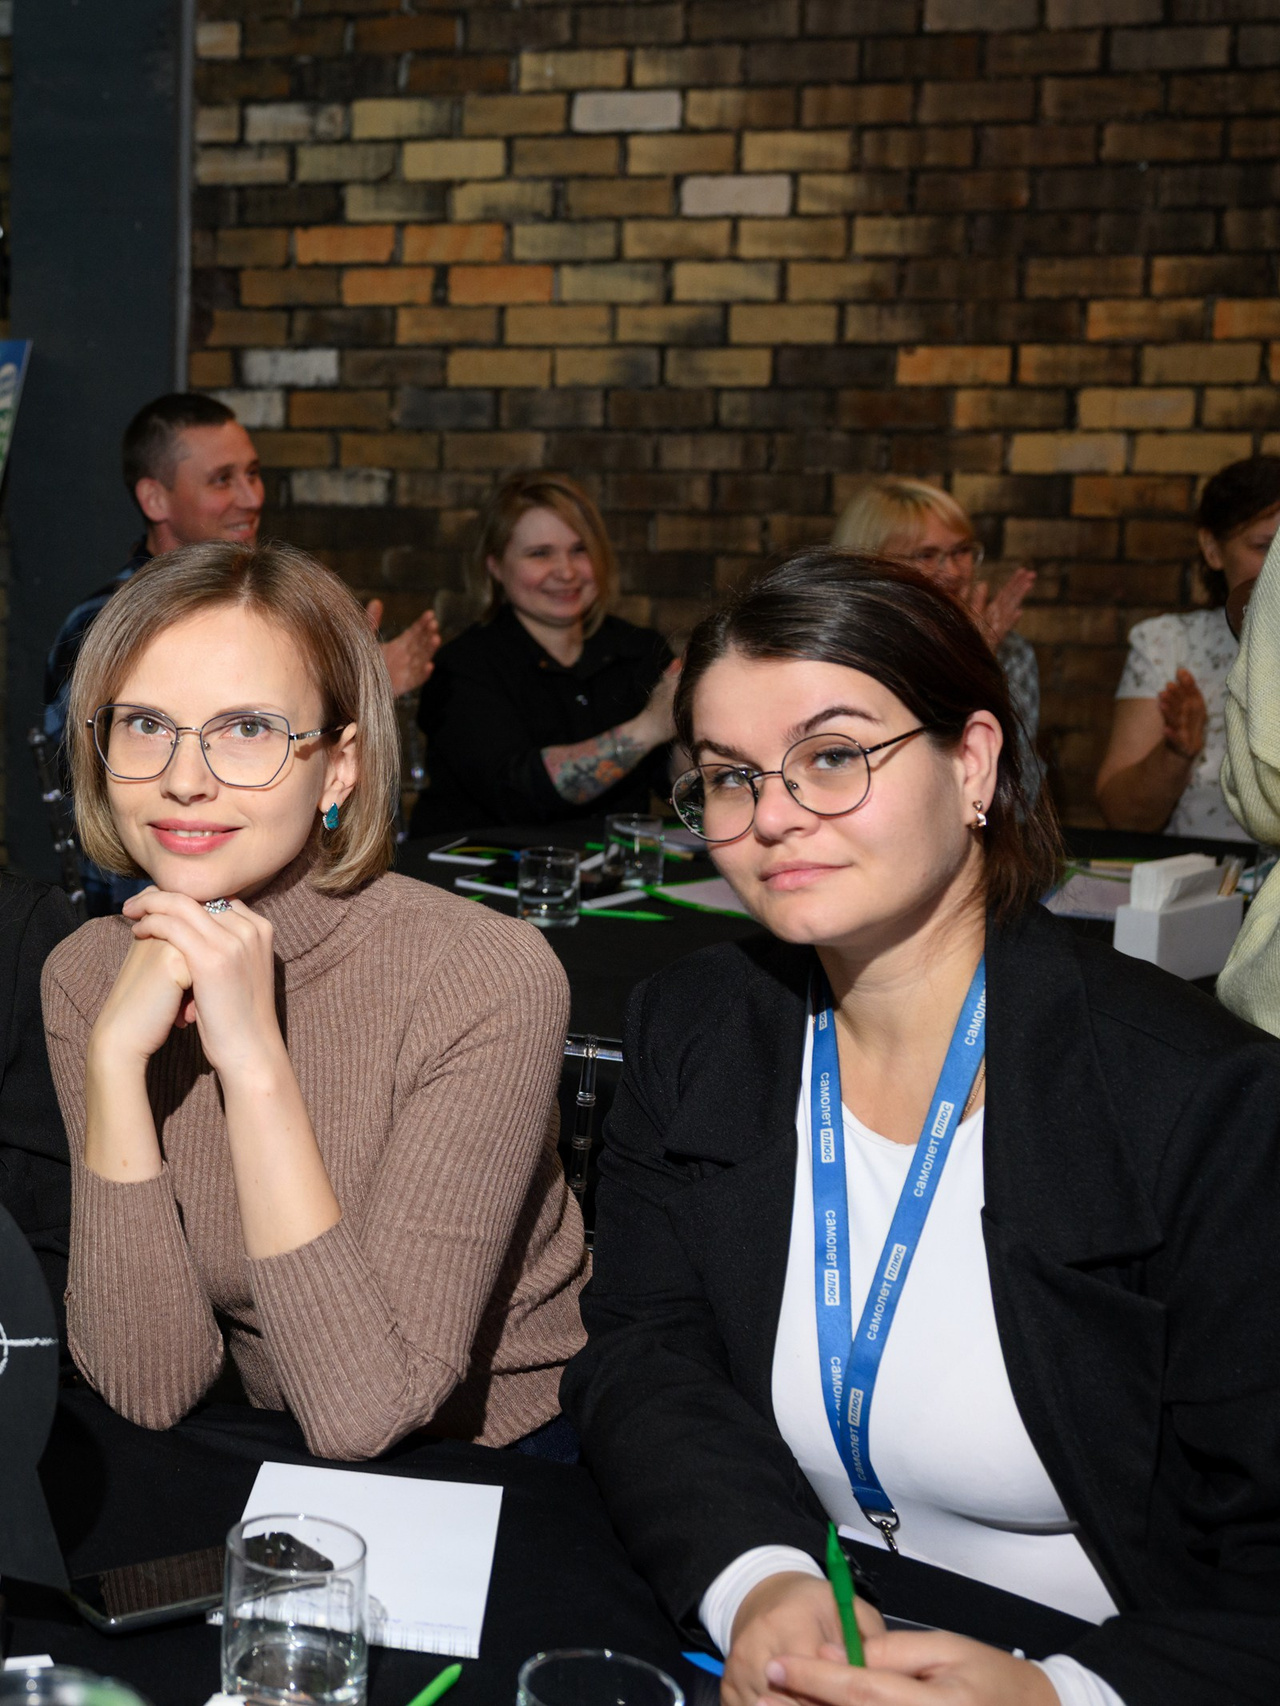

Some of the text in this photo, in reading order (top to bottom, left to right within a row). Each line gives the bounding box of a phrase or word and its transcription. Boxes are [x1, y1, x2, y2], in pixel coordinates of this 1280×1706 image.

[964, 988, 986, 1046] самол
[820, 1072, 832, 1127] самолет
[913, 1138, 940, 1198] самолет
[825, 1209, 837, 1268] самолет
[866, 1281, 893, 1341] самолет
[849, 1426, 867, 1482] самолет
